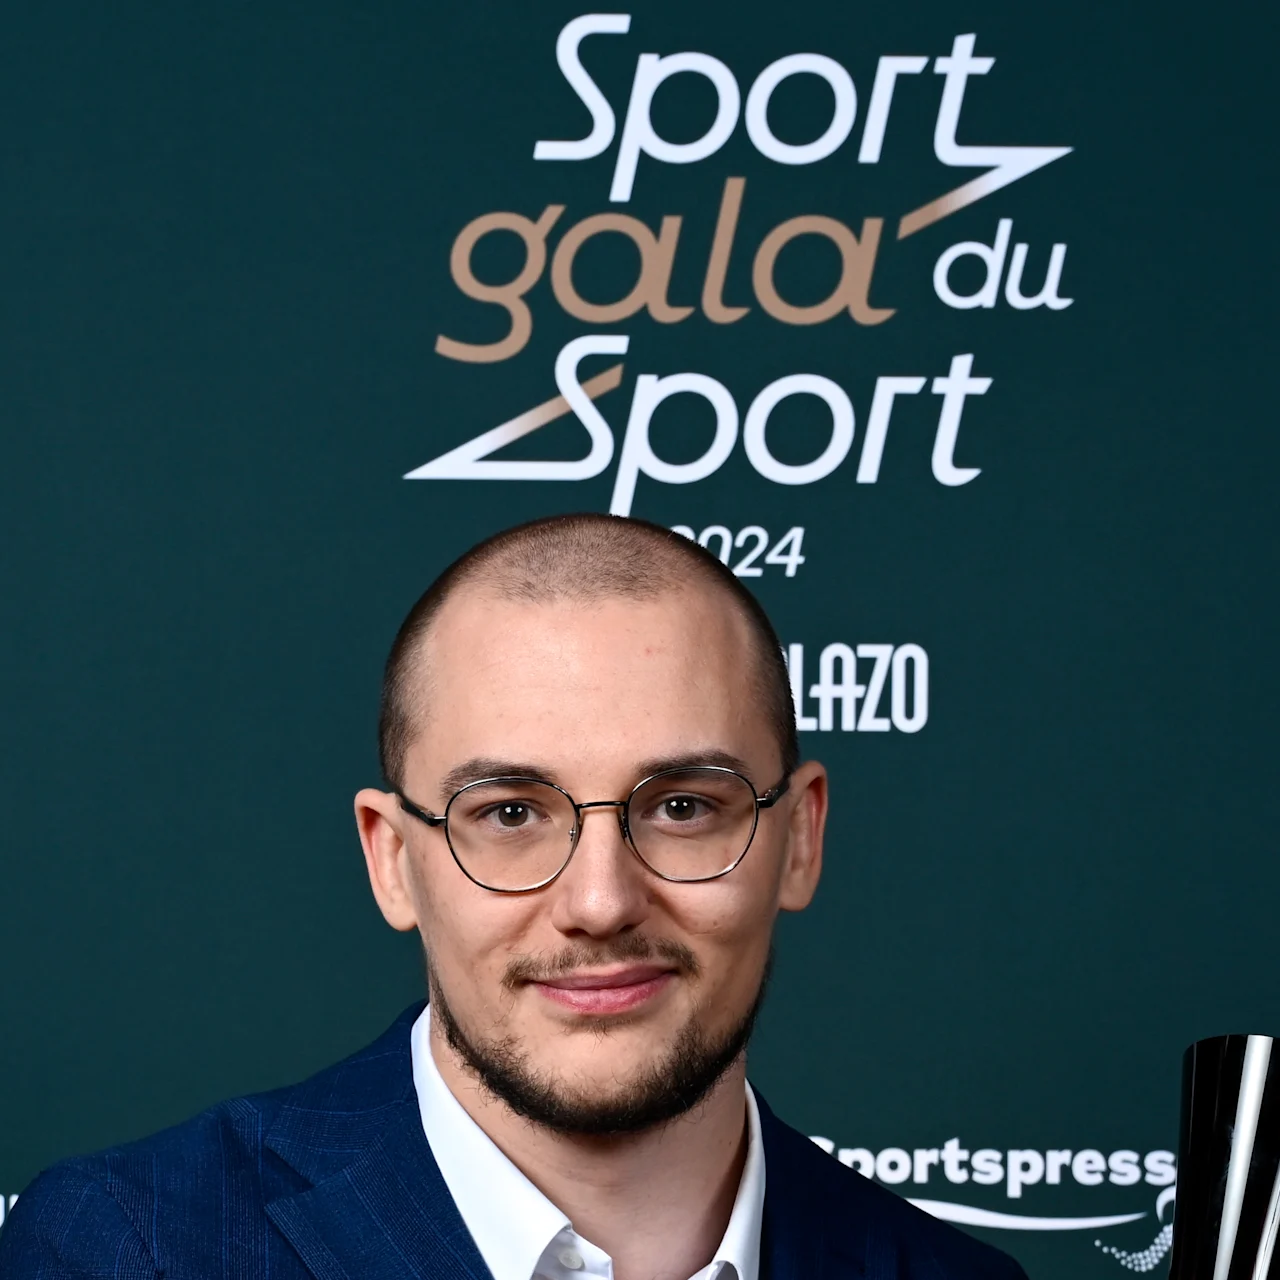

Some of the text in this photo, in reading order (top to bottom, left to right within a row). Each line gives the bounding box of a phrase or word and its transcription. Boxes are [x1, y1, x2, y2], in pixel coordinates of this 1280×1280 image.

[532, 14, 1075, 202] Sport
[434, 174, 1073, 364] gala du
[402, 335, 993, 517] Sport
[672, 525, 805, 577] 024
[781, 643, 928, 733] LAZO
